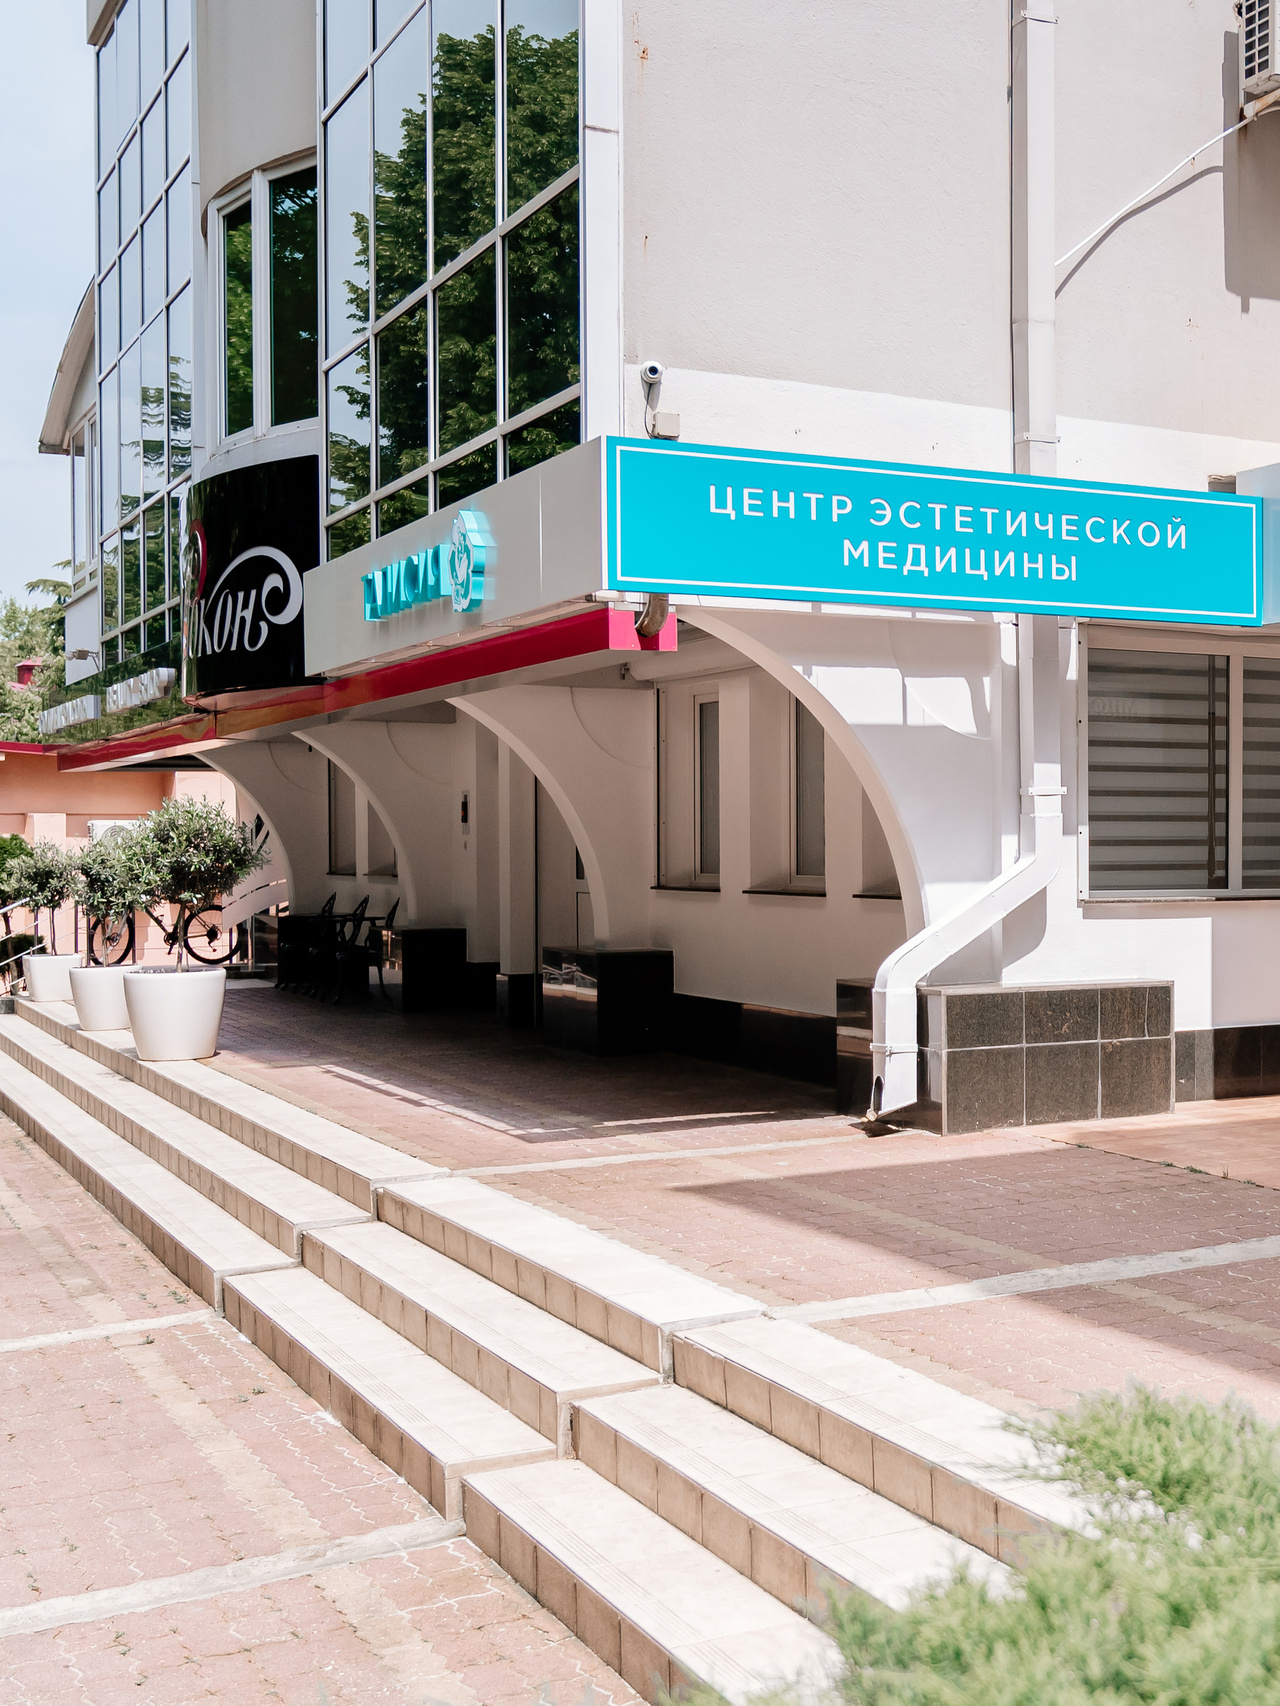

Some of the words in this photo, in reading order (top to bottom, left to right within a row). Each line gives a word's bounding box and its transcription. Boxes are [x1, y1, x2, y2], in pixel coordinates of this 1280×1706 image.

[708, 483, 854, 522] ЦЕНТР
[868, 497, 1187, 550] ЭСТЕТИЧЕСКОЙ
[842, 538, 1078, 582] МЕДИЦИНЫ
